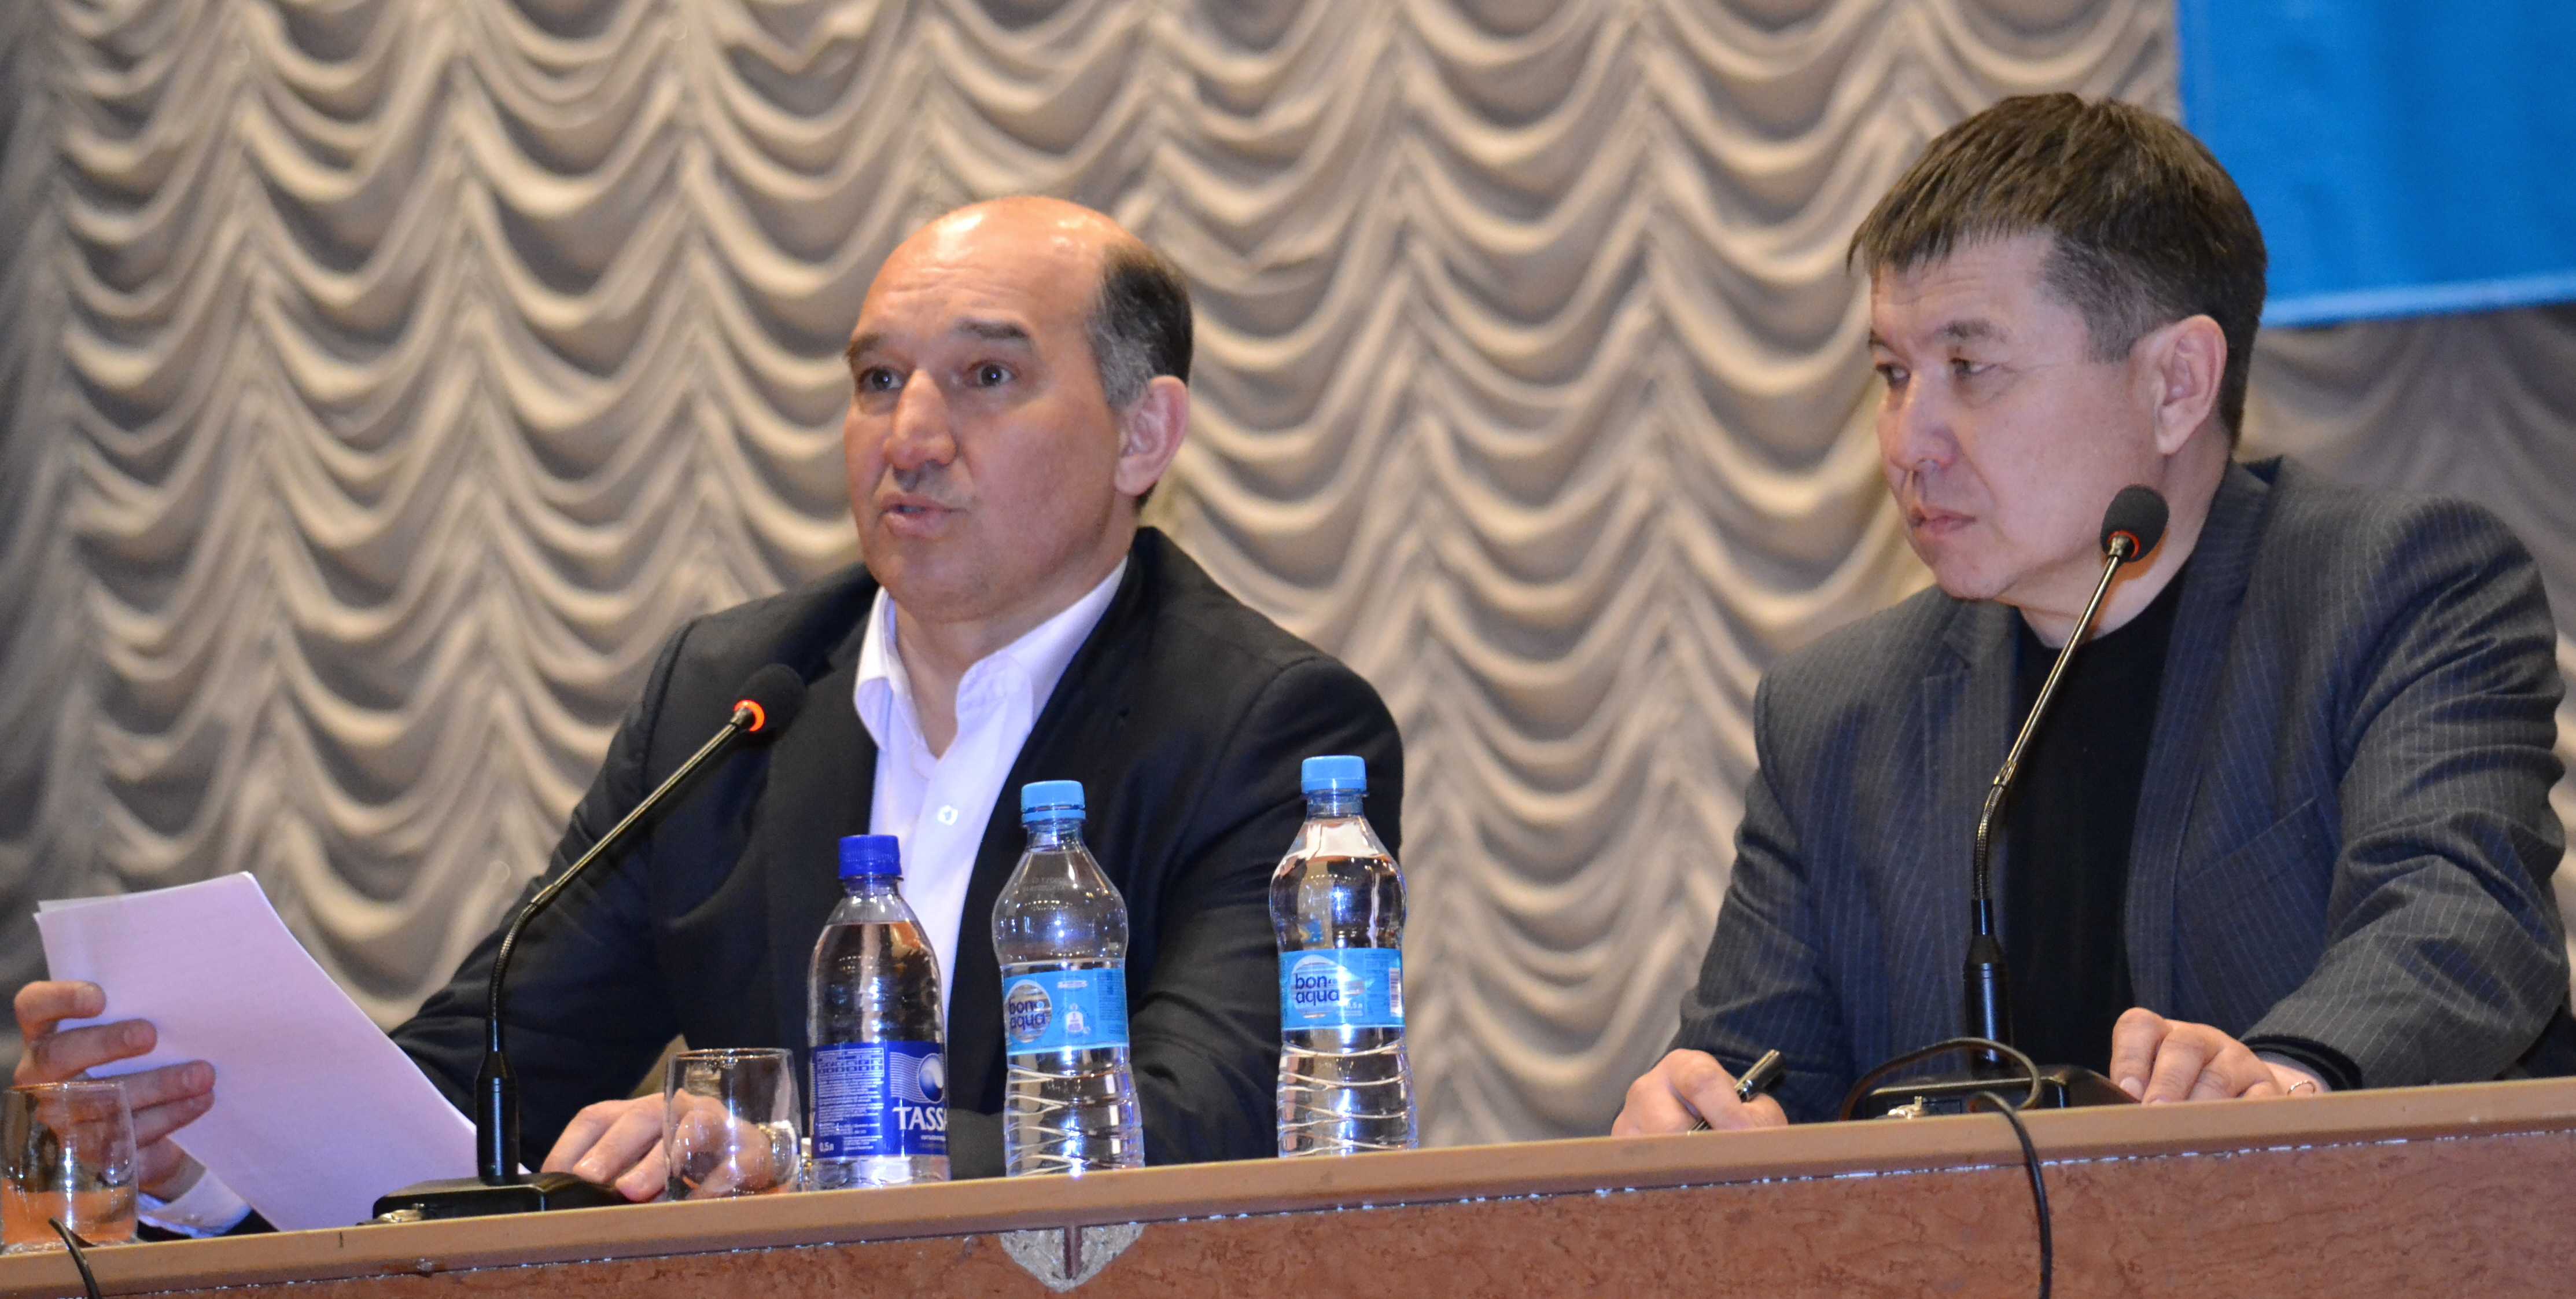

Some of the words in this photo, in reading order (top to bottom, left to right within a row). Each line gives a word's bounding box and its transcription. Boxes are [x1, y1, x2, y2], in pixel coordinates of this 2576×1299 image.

[1295, 973, 1327, 989] bon
[1008, 997, 1034, 1015] bon
[1296, 989, 1340, 1006] aqua
[1010, 1013, 1046, 1031] aqua
